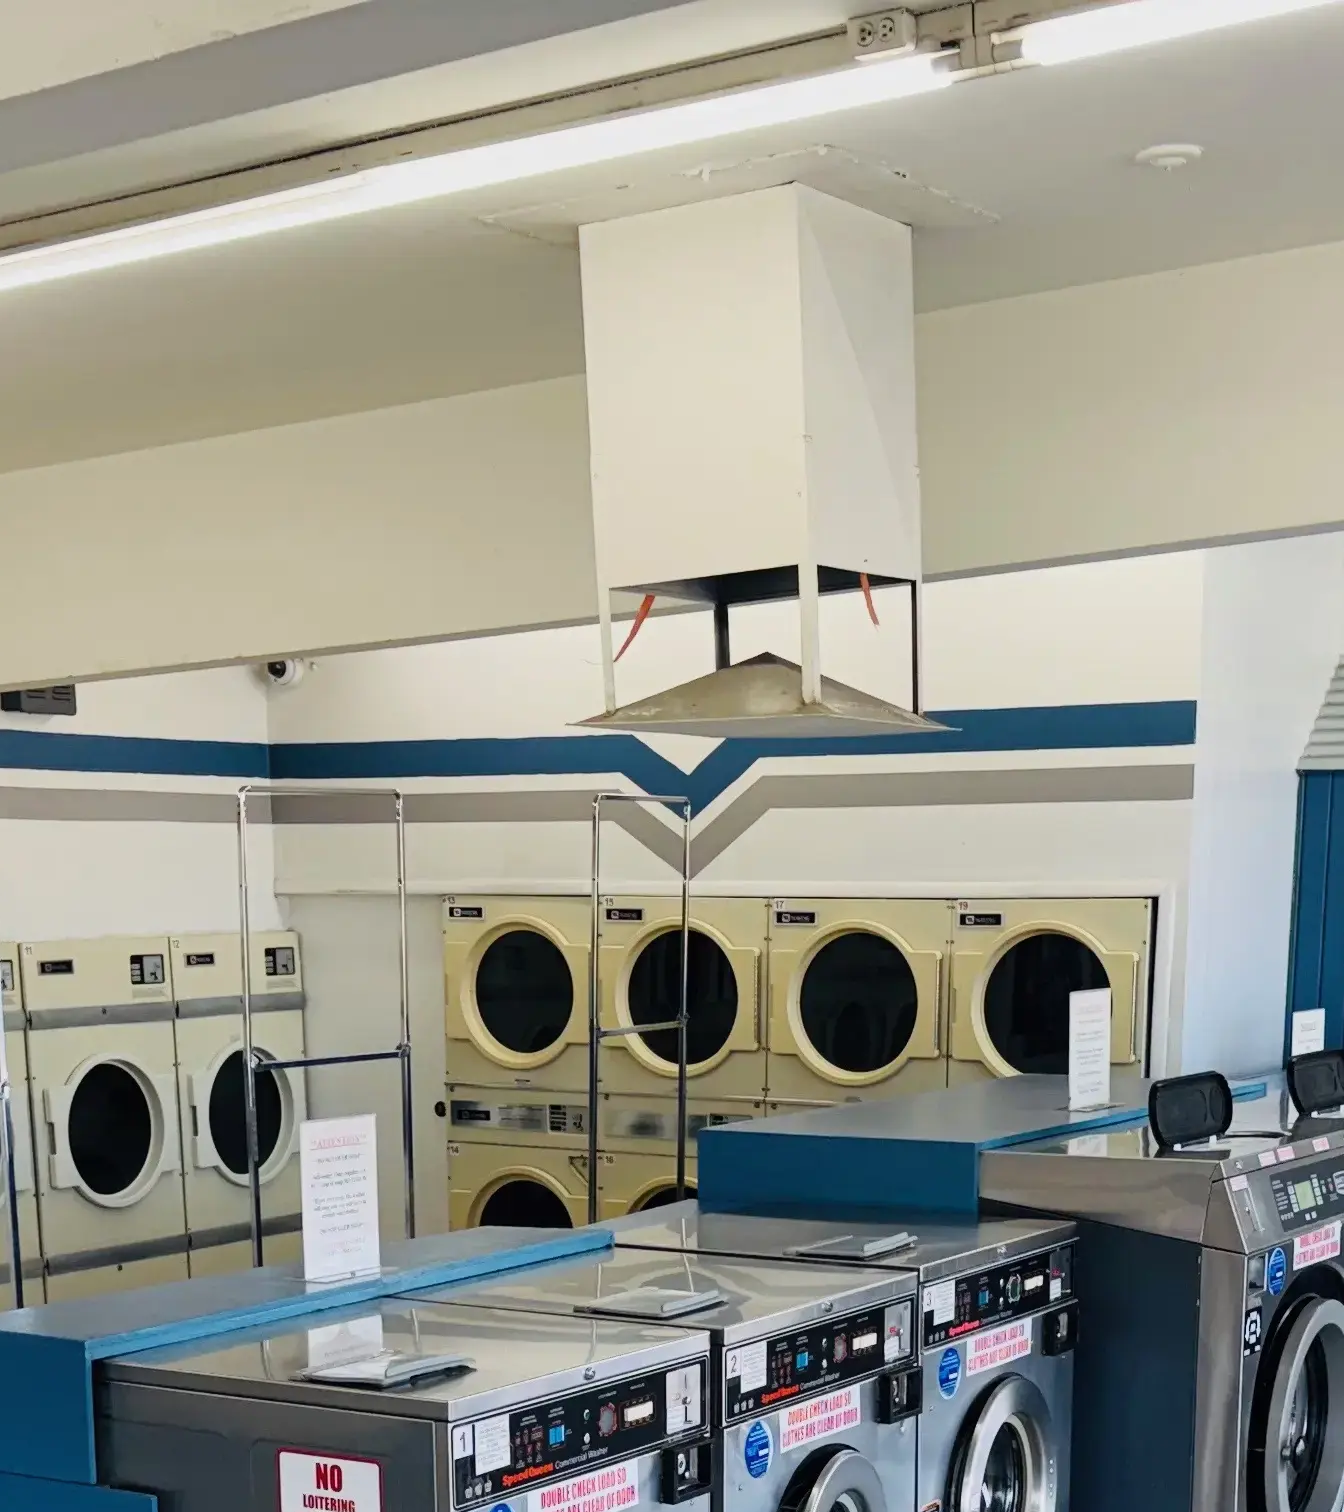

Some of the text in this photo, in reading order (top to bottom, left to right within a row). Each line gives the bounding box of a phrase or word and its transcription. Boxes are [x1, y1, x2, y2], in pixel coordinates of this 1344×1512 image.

[730, 1353, 738, 1373] 2
[459, 1431, 466, 1453] 1
[555, 1453, 587, 1470] Commercial
[314, 1462, 343, 1493] NO
[540, 1467, 626, 1510] DOUBLE CHECK LOAD SO
[606, 1491, 615, 1509] OF
[616, 1485, 636, 1507] DOOR
